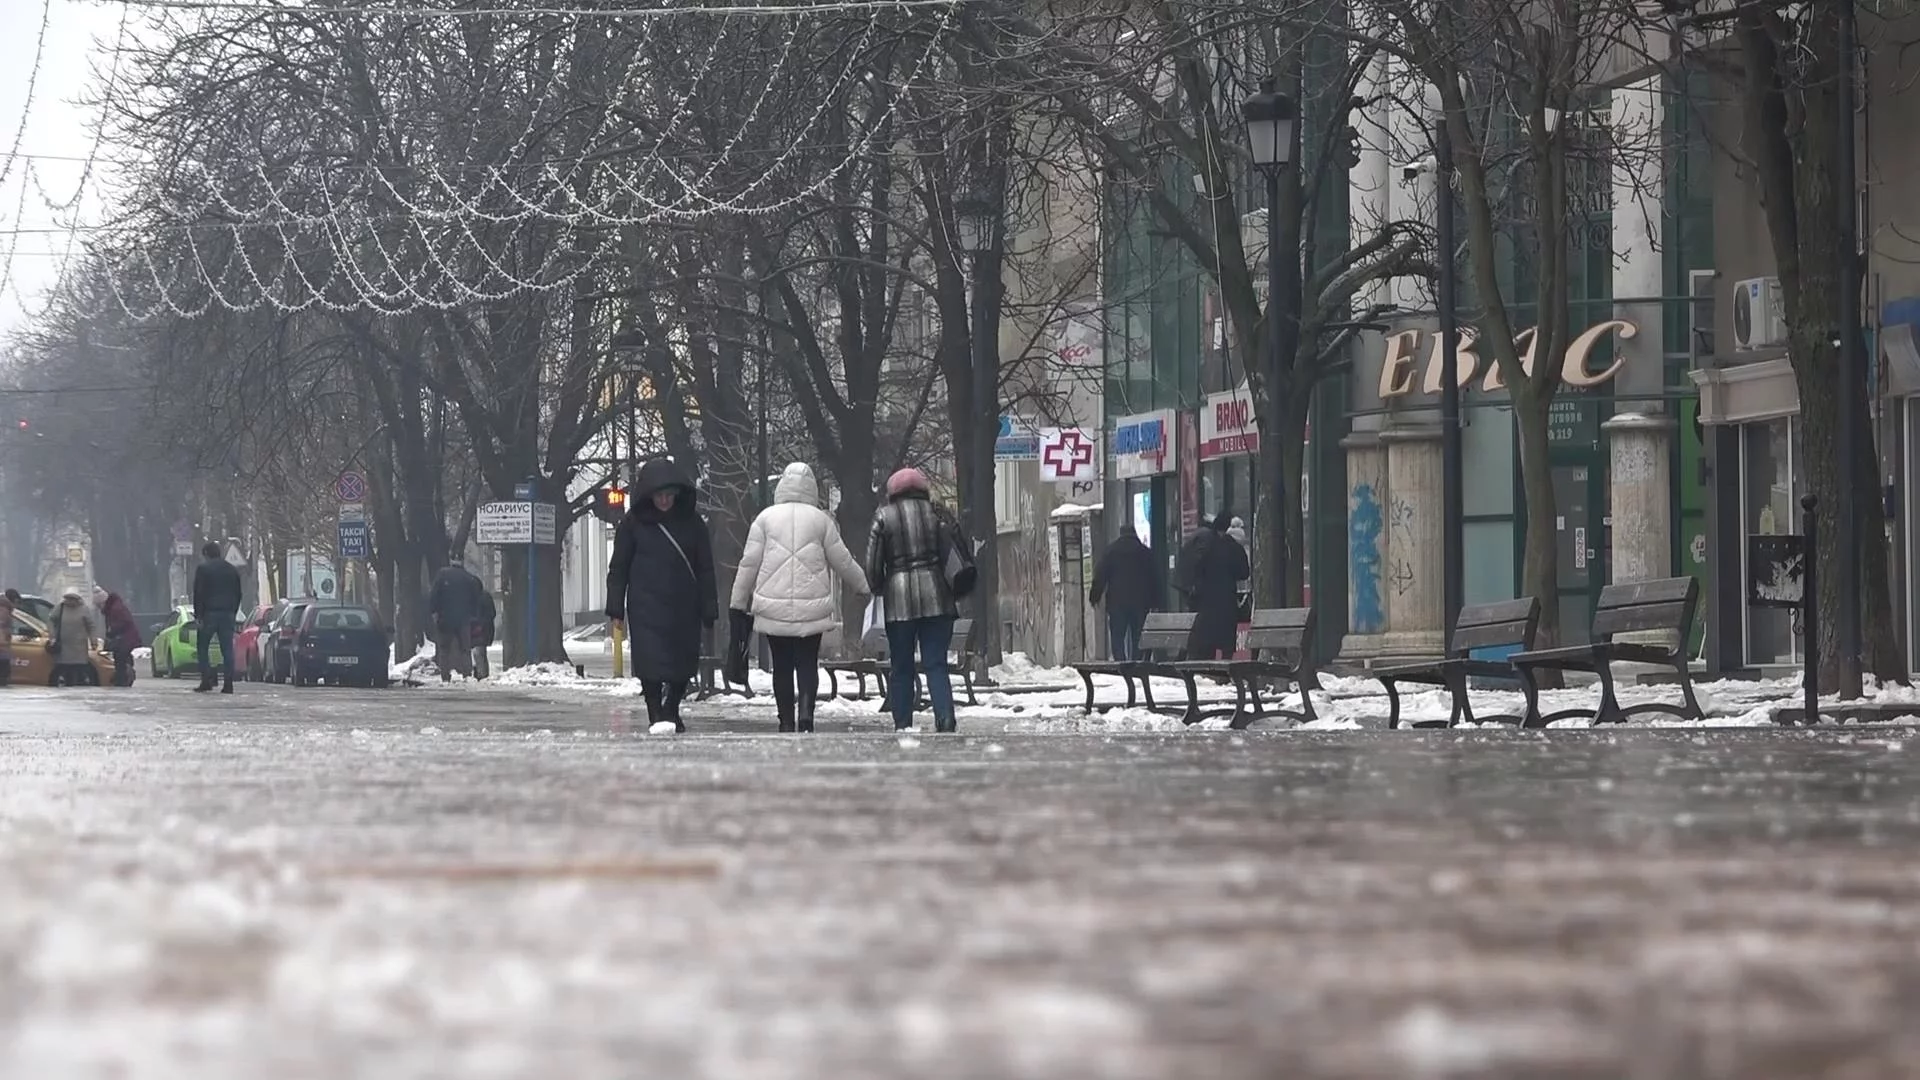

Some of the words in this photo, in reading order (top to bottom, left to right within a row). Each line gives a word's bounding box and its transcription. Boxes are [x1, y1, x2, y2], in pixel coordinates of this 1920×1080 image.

[1216, 398, 1248, 432] BRAVO
[1219, 437, 1247, 451] MOBILE
[480, 504, 530, 514] НОТАРИУС
[340, 528, 364, 537] ТАКСИ
[343, 537, 362, 546] TAXI
